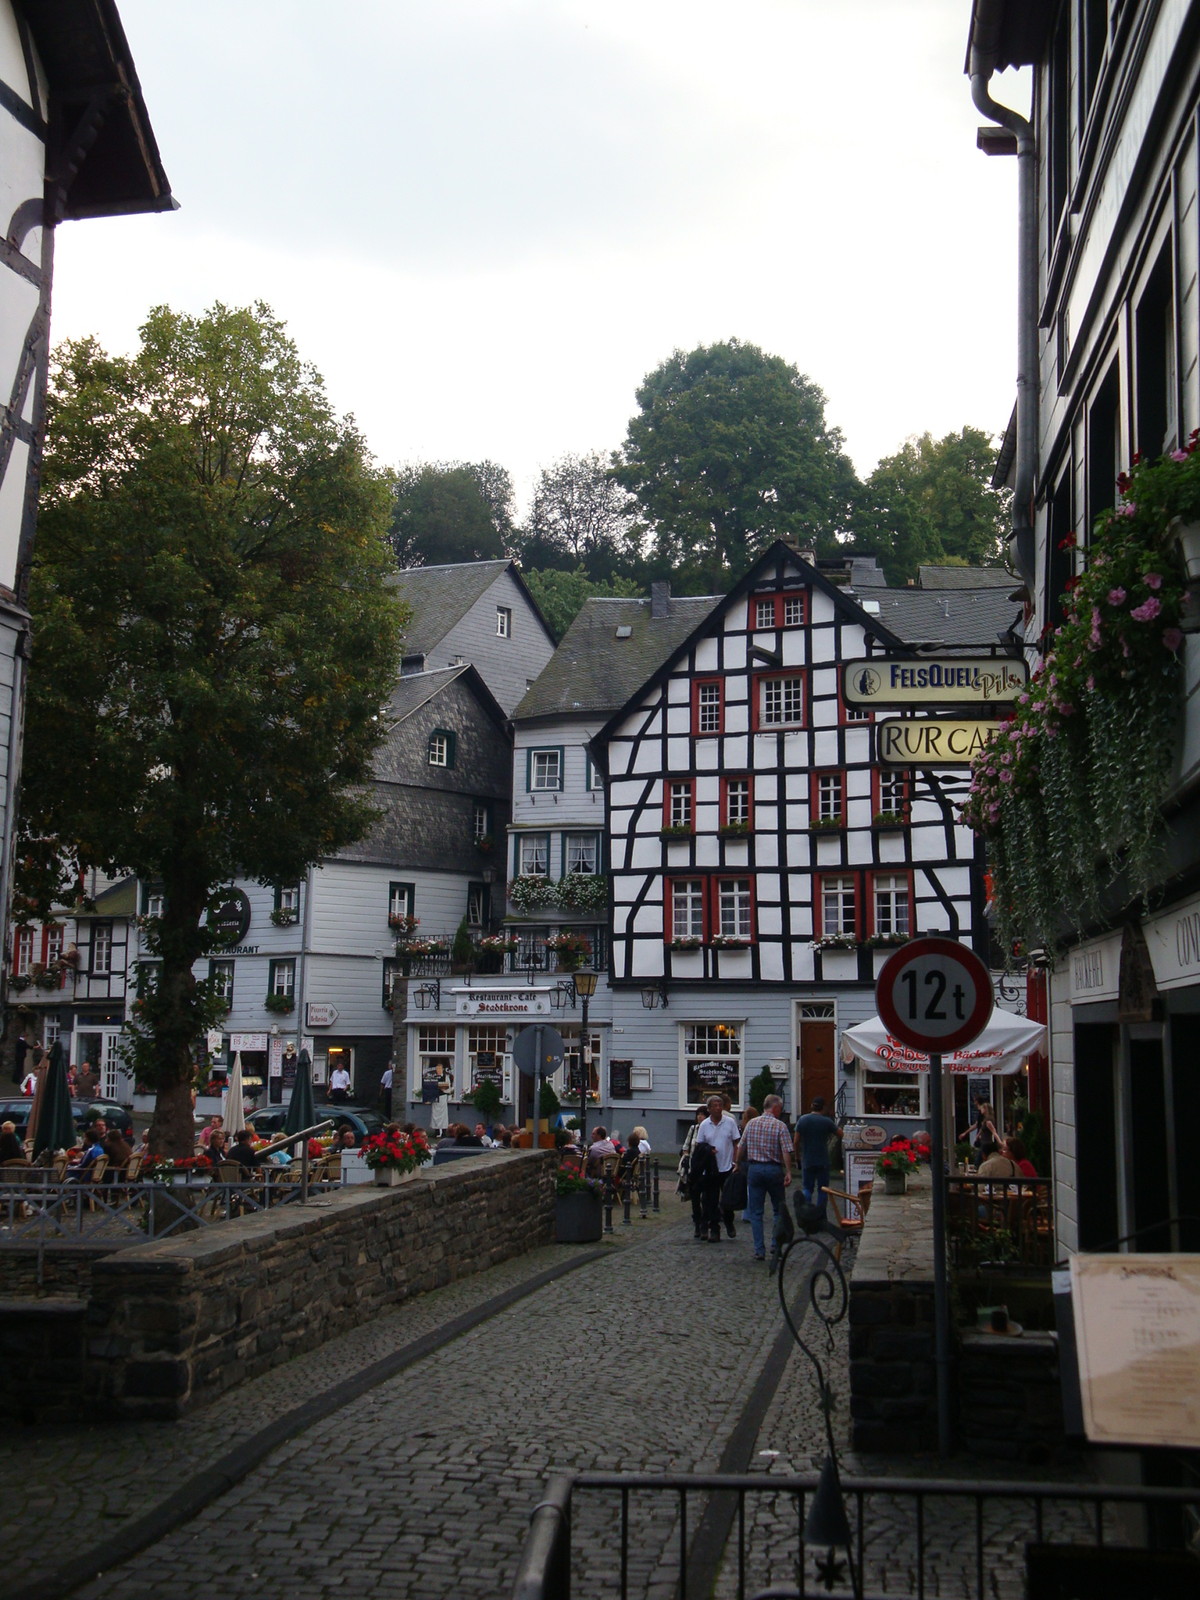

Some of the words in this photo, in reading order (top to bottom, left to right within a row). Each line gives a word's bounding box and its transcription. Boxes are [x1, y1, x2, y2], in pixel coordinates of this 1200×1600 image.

[885, 726, 942, 757] RUR
[206, 946, 259, 955] ETAURANT
[953, 1048, 1005, 1061] Bäckerei
[948, 1063, 992, 1073] Bäckerei
